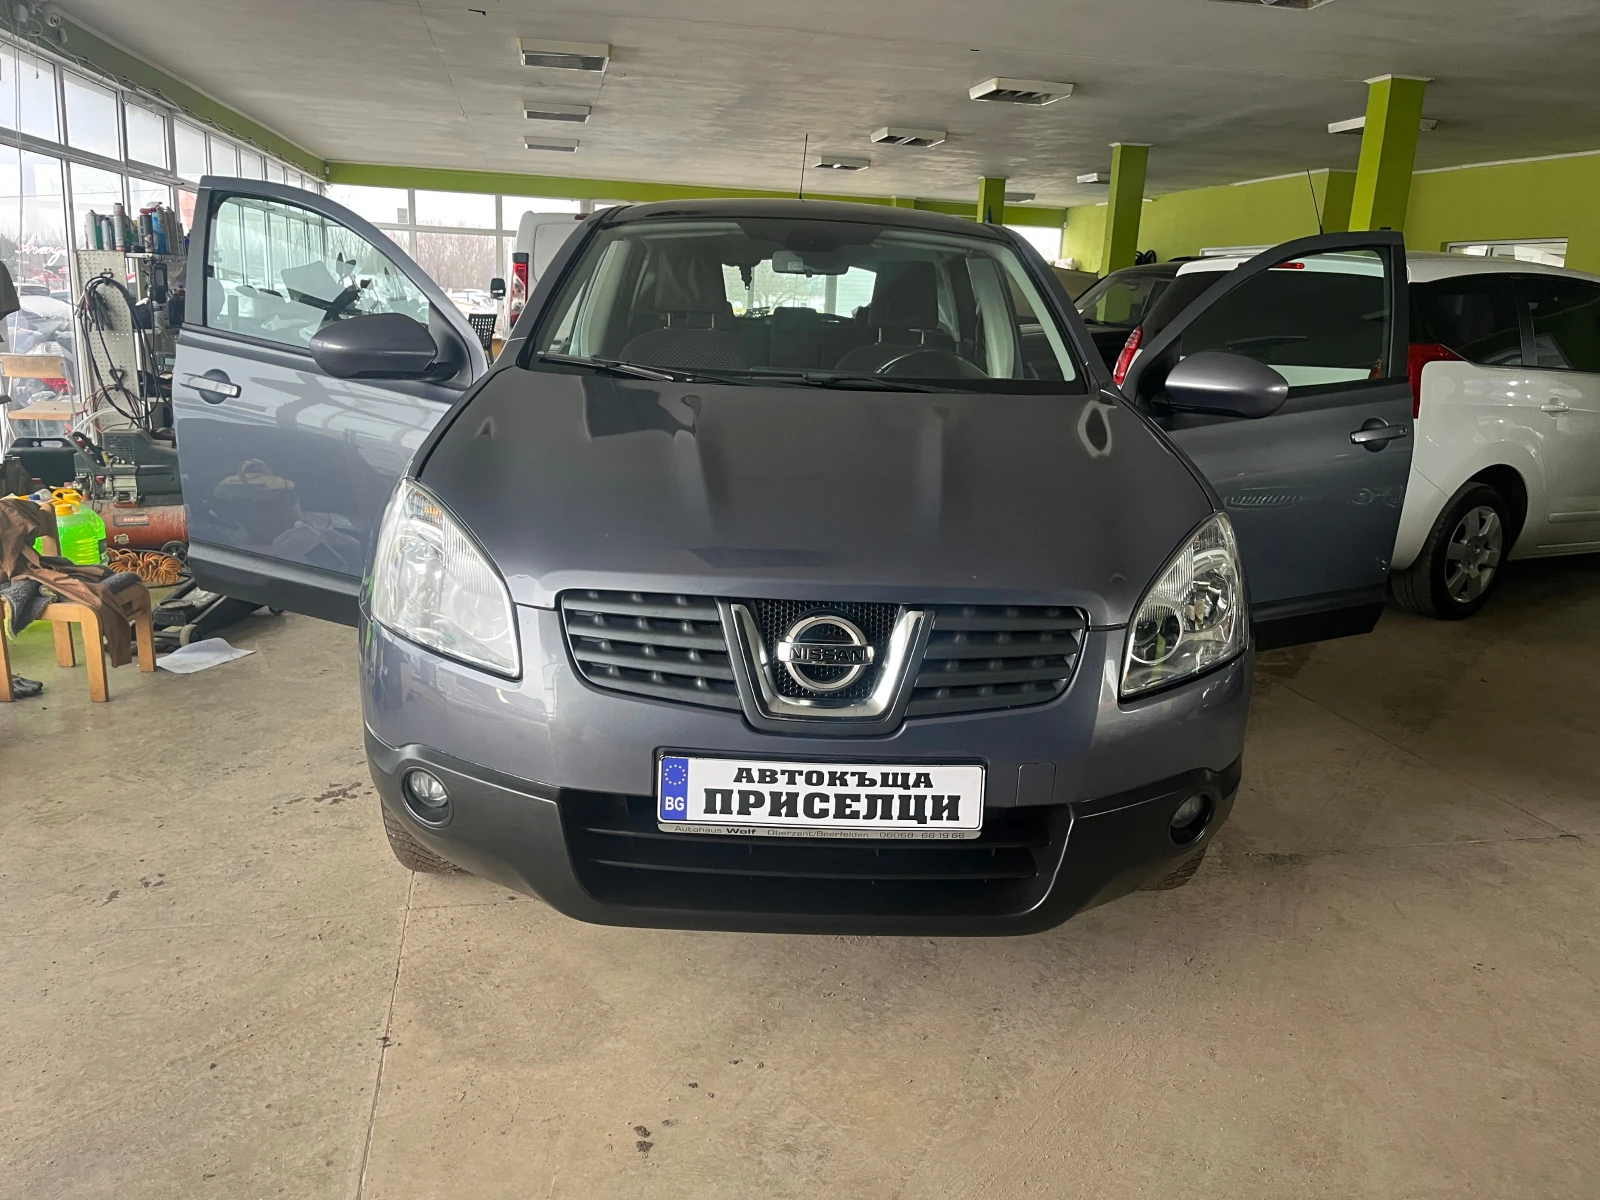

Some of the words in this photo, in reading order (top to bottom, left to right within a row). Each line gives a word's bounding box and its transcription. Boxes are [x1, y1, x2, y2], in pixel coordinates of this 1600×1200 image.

[790, 647, 865, 661] NISSAN
[732, 767, 934, 789] АВТОКЪЩА
[664, 796, 685, 811] BG
[703, 787, 961, 824] ПРИСЕЛЦИ
[674, 825, 723, 834] Autohaus
[726, 827, 757, 835] Wolf
[879, 831, 914, 839] 06068
